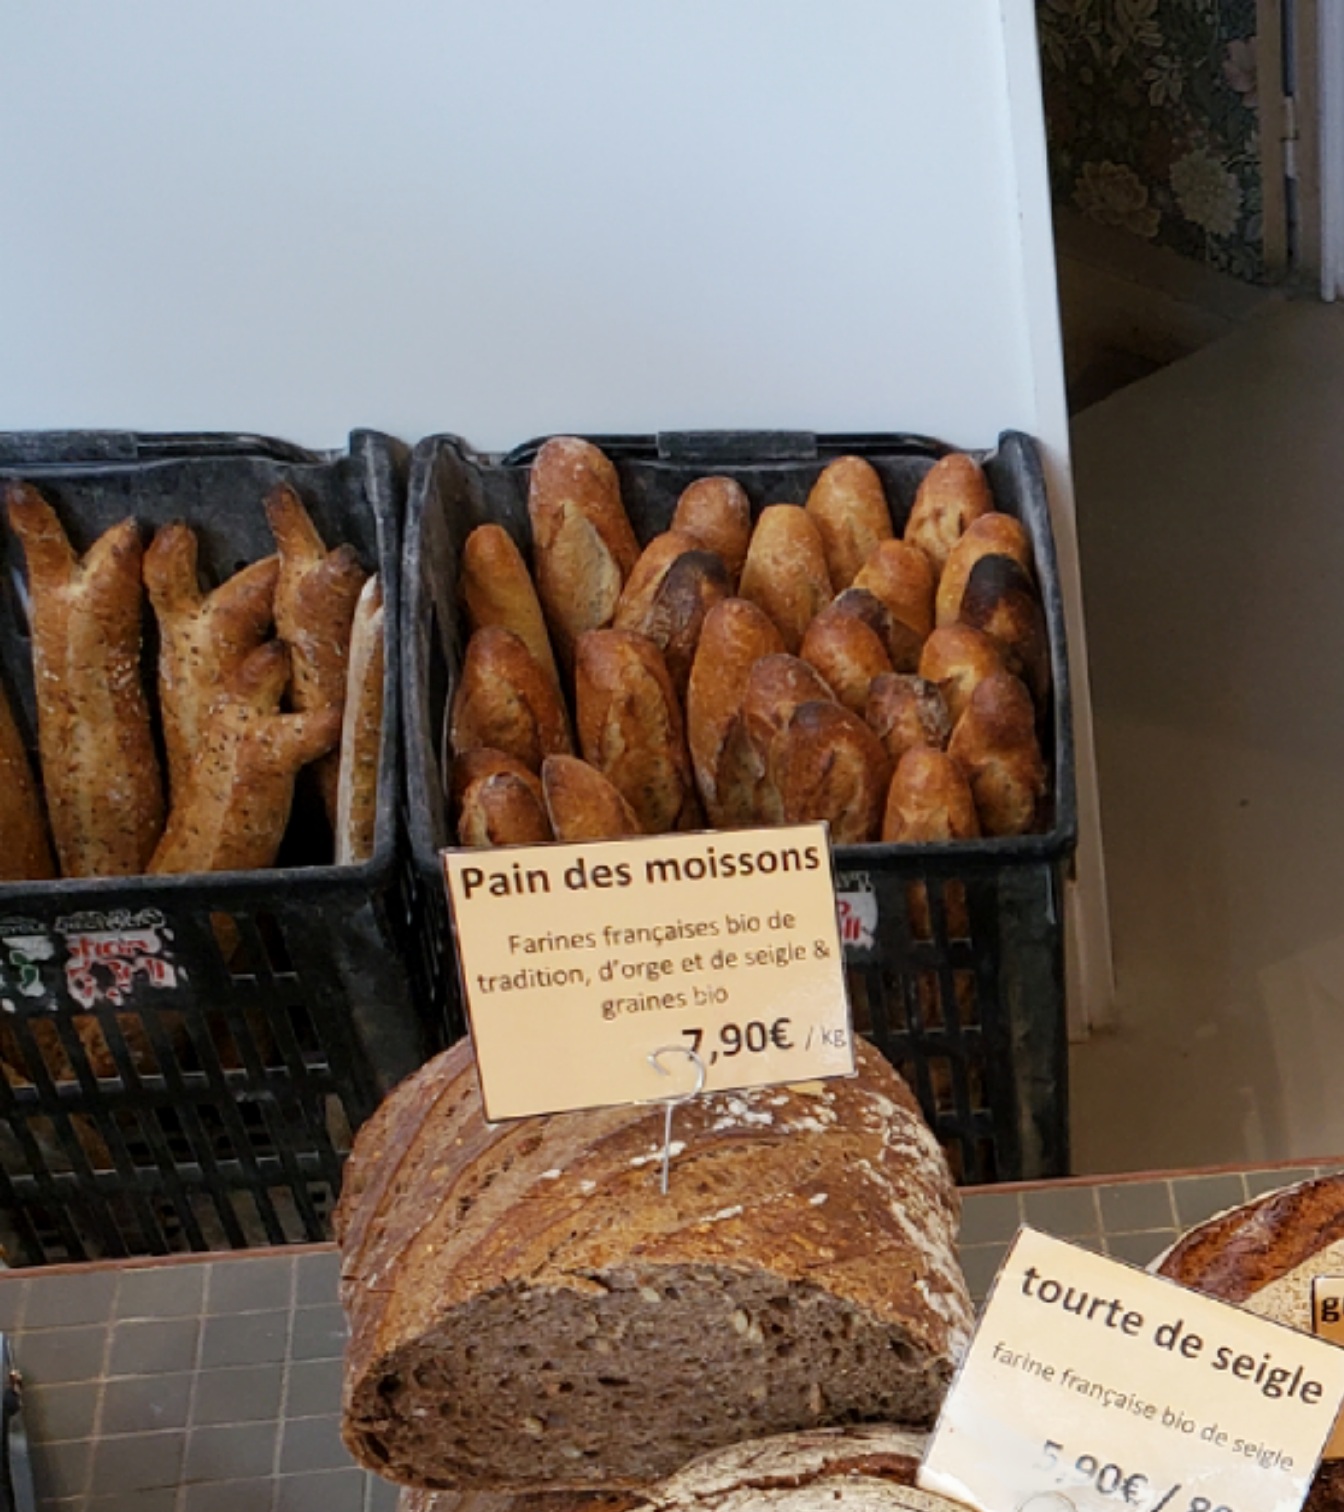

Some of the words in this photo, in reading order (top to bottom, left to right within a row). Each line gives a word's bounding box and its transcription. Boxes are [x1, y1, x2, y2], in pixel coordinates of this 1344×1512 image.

[461, 864, 550, 898] Pain
[564, 859, 631, 891] des
[646, 845, 820, 884] moissons
[509, 931, 595, 955] Farines
[603, 919, 720, 947] françaises
[726, 914, 759, 933] bio
[767, 911, 796, 930] de
[477, 966, 591, 994] tradition,
[681, 955, 704, 973] et
[711, 948, 737, 969] de
[745, 944, 805, 966] seigle
[813, 941, 830, 959] &
[602, 991, 688, 1020] graines
[694, 985, 728, 1006] bio
[681, 1017, 794, 1066] 7,90€
[821, 1024, 846, 1047] kg
[1021, 1266, 1144, 1336] tourte
[1155, 1320, 1203, 1358] de
[1212, 1344, 1324, 1405] seigle
[992, 1342, 1055, 1383] farine
[1060, 1369, 1157, 1420] française
[1162, 1406, 1195, 1434] bio
[1201, 1423, 1228, 1447] de
[1233, 1438, 1294, 1472] seigle
